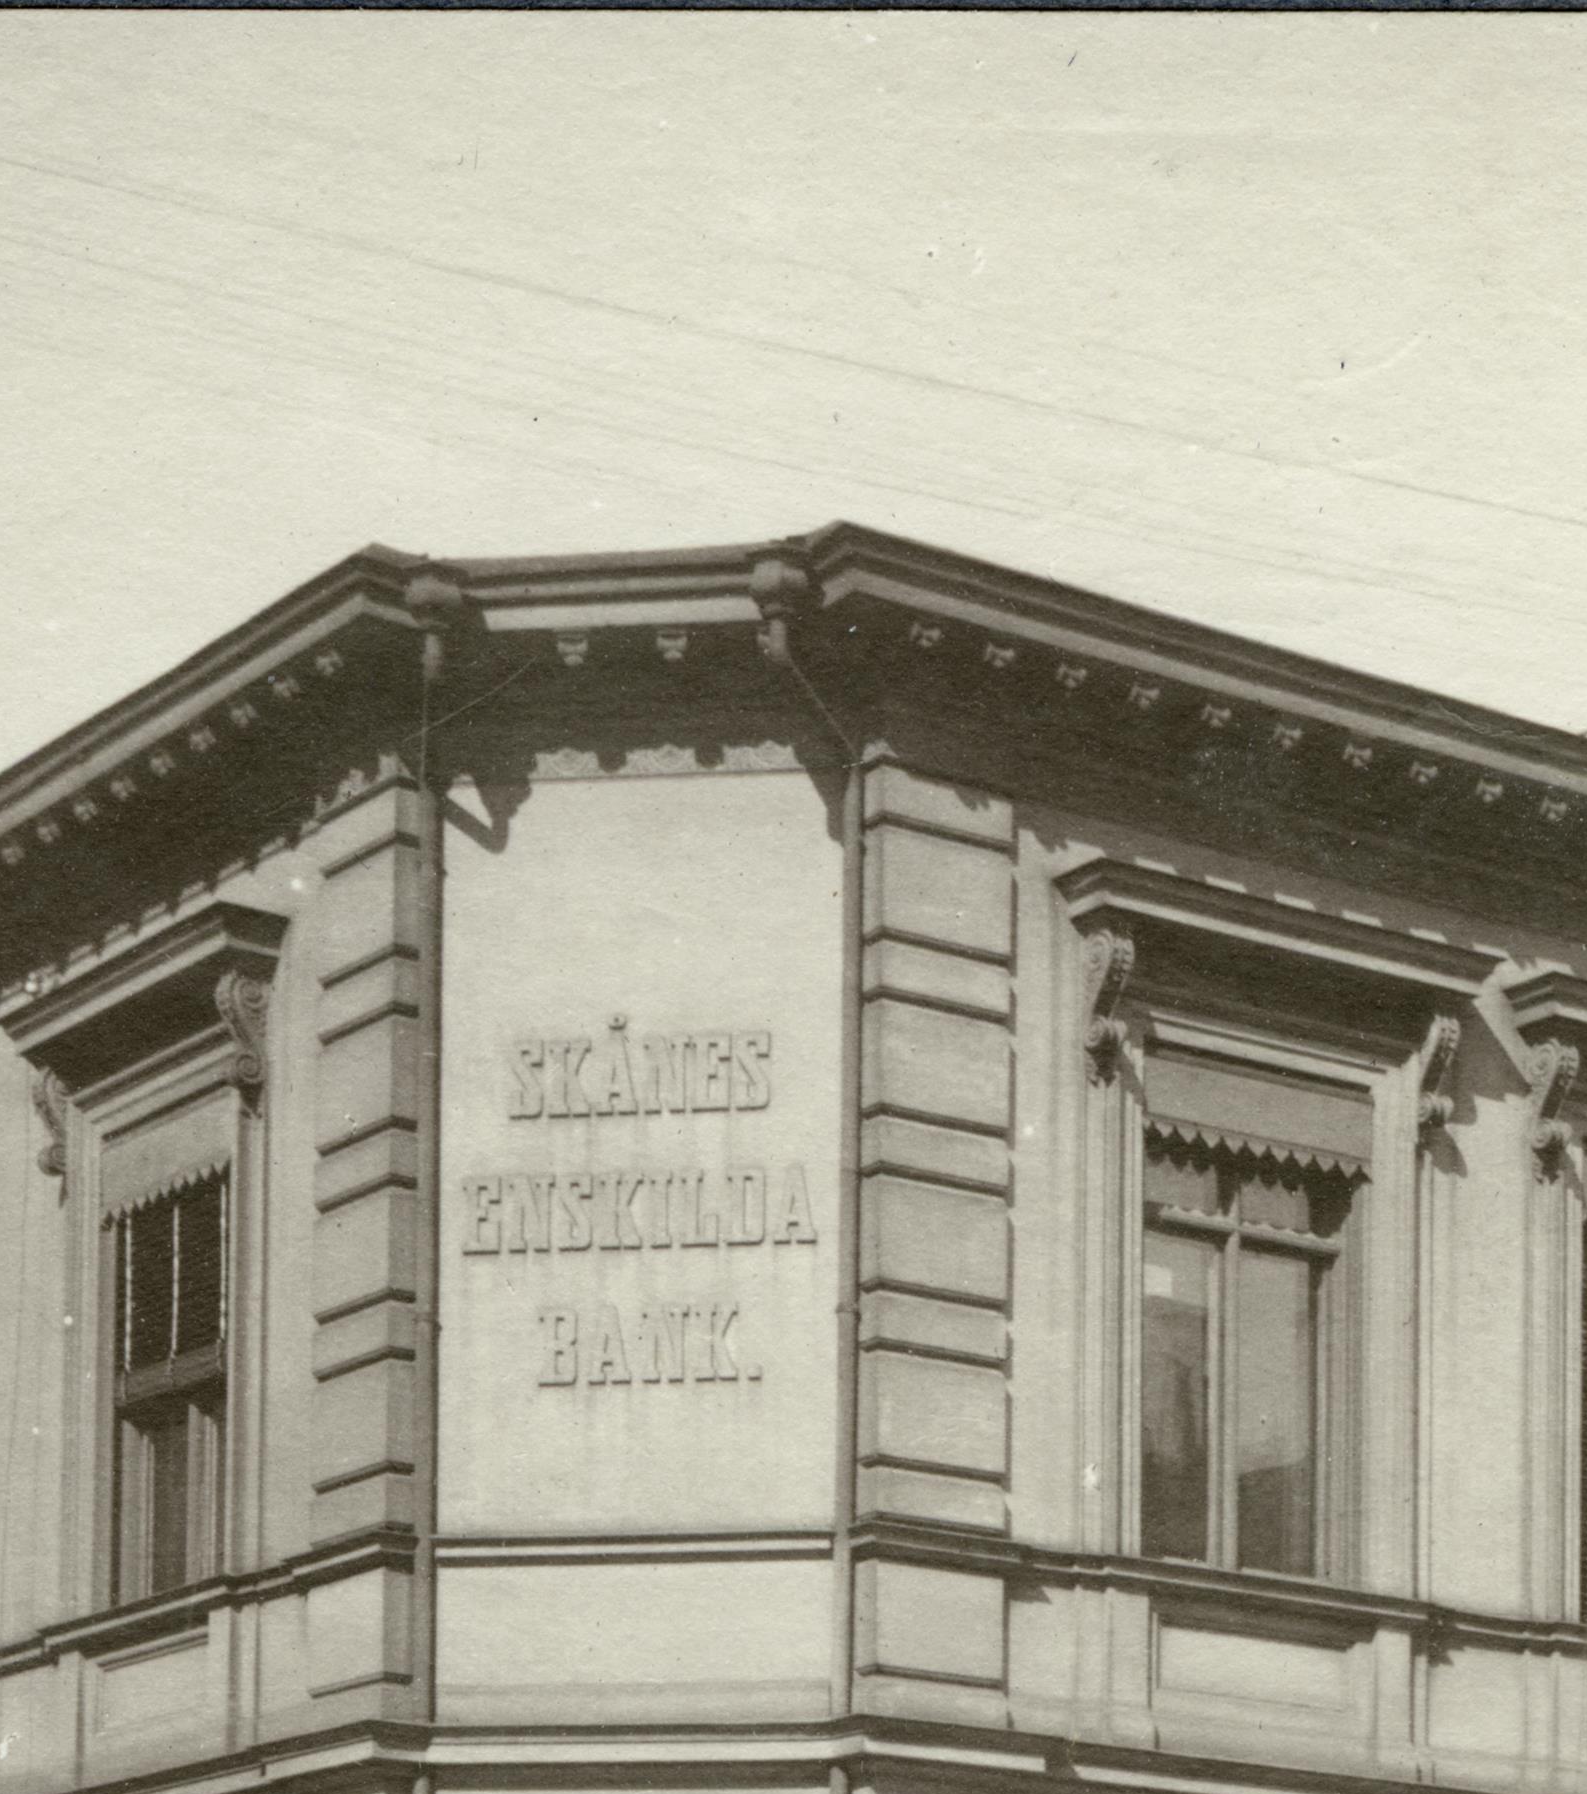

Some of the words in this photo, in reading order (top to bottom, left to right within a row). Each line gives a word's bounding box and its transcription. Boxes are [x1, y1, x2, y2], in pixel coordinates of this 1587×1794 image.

[508, 1013, 772, 1120] SKÅNES
[461, 1163, 818, 1256] ENSKILDA
[538, 1302, 763, 1388] BANK.
